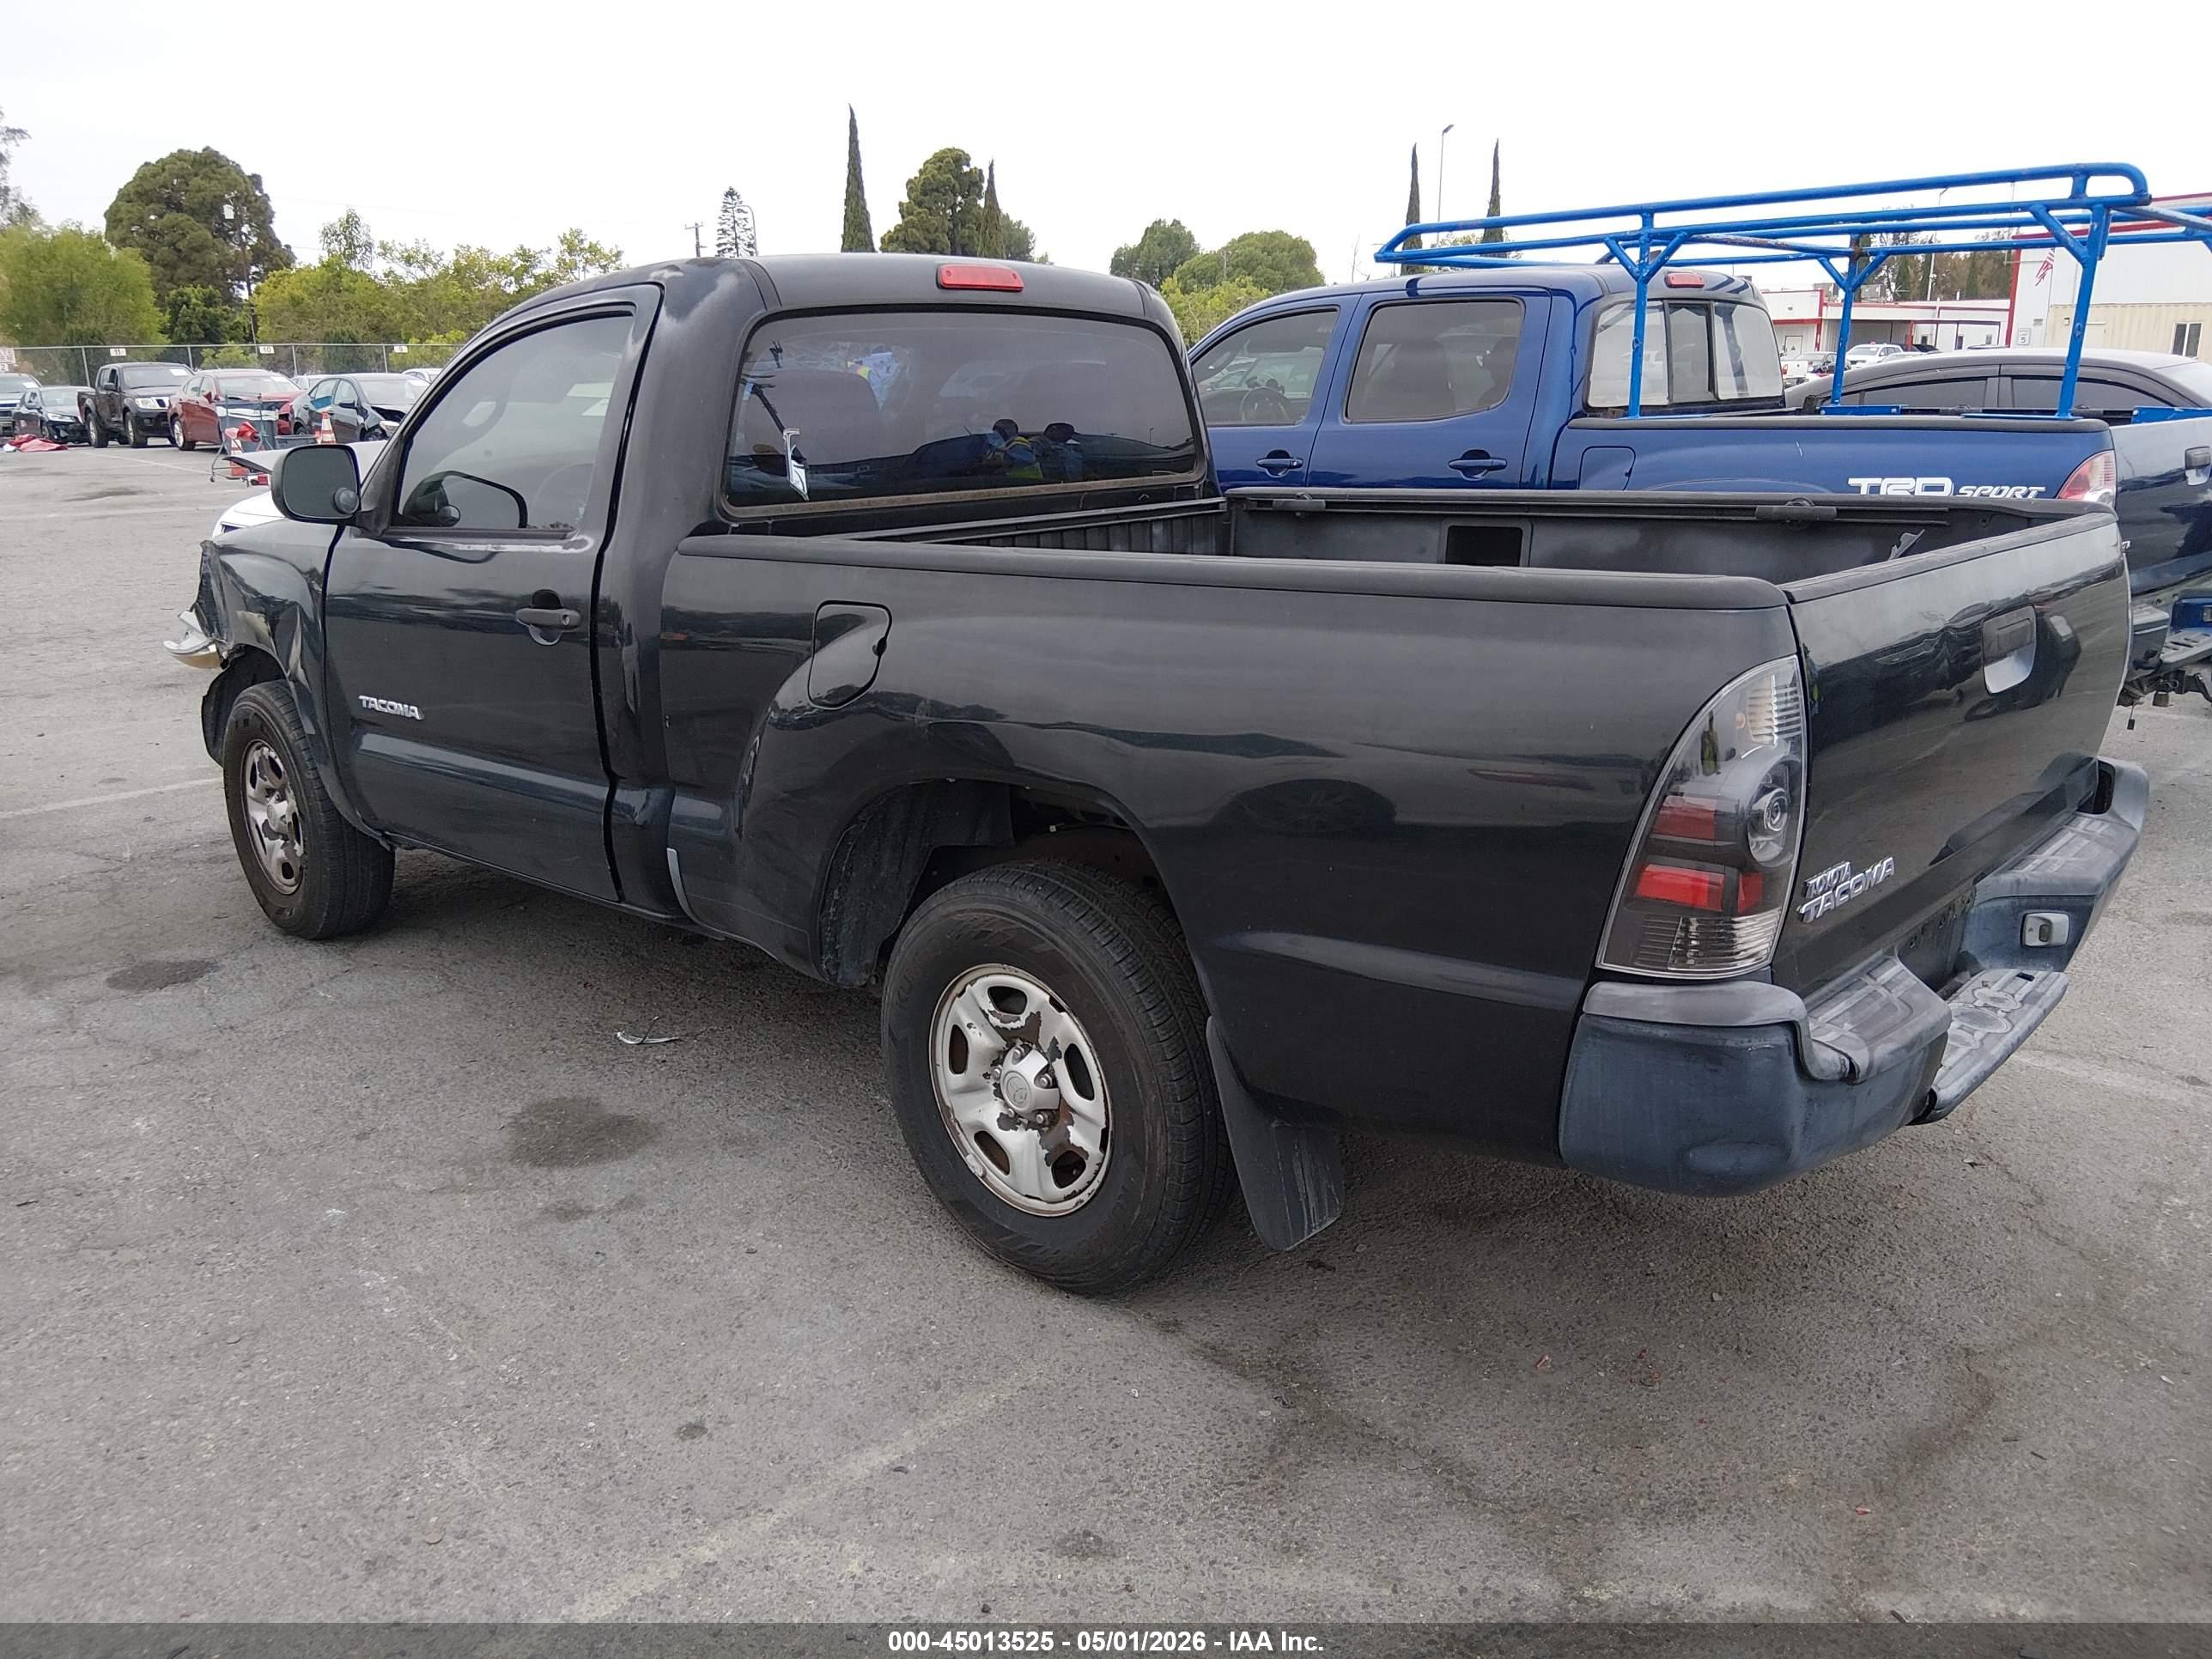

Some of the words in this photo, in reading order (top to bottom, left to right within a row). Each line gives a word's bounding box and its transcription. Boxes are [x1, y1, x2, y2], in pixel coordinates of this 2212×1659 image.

[1847, 477, 1954, 496] TRD
[1958, 485, 2047, 499] SPORT
[358, 695, 425, 720] TACOMA
[1796, 856, 1895, 923] TACOMA
[1805, 860, 1851, 898] TOYOTA
